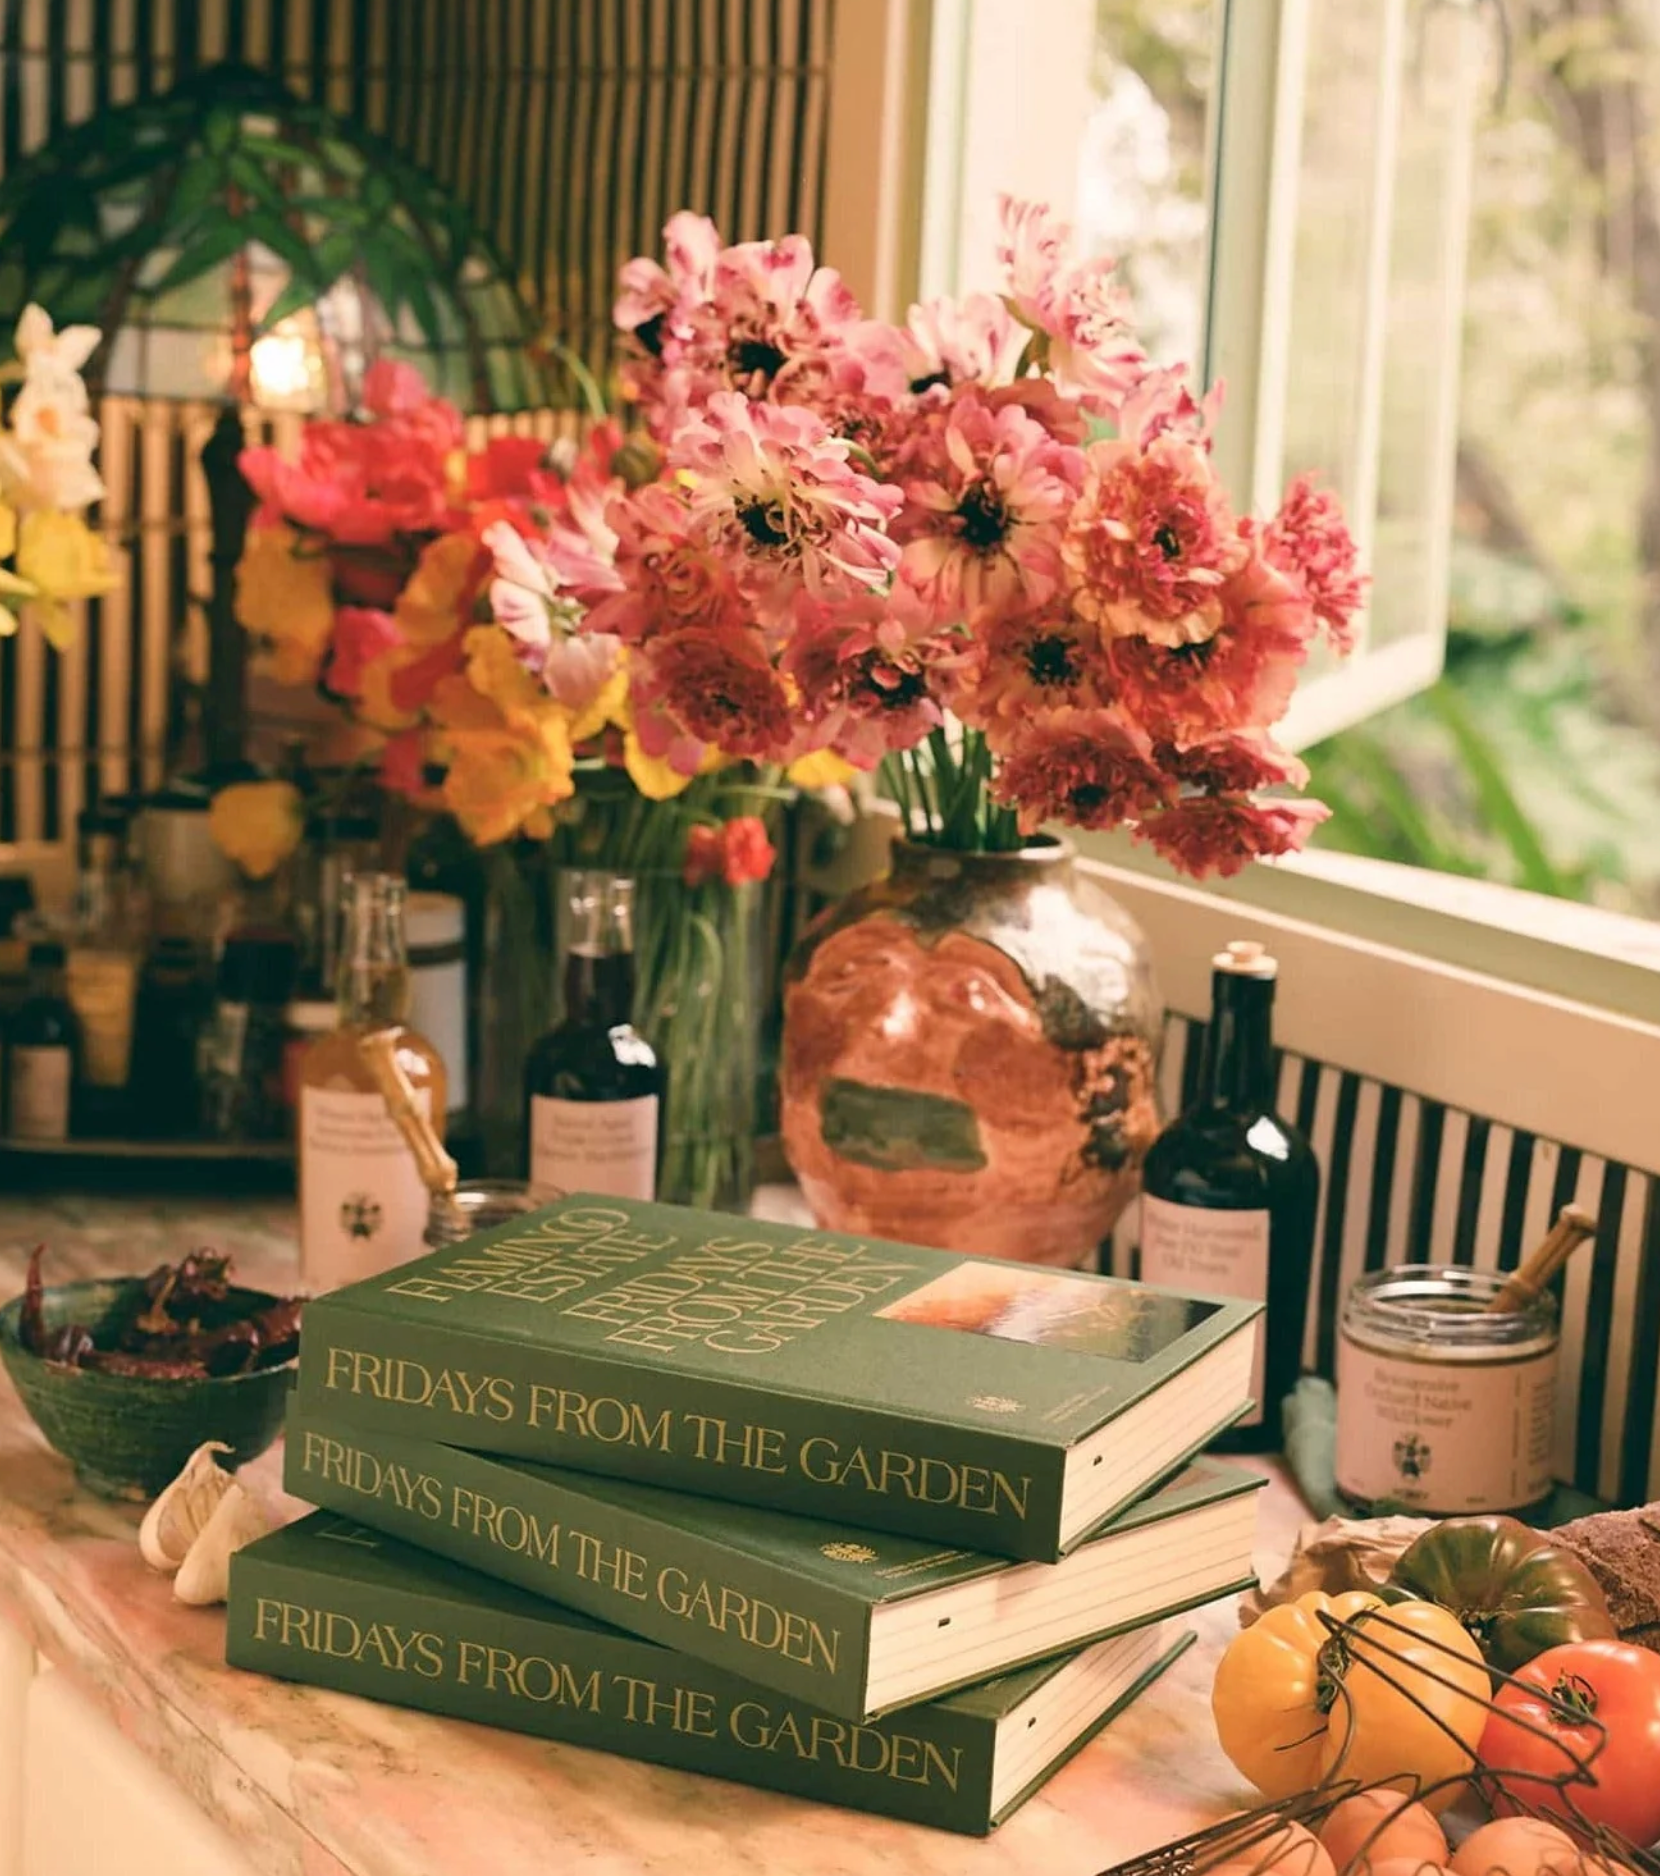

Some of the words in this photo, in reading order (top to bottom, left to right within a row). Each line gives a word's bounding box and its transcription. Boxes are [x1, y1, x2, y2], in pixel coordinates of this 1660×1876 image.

[385, 1207, 630, 1303] FLAMINGO
[484, 1229, 678, 1303] ESTATE
[560, 1237, 774, 1325] FRIDAYS
[604, 1281, 788, 1354] FROM
[736, 1236, 869, 1283] THE
[703, 1256, 920, 1354] GARDEN
[325, 1347, 515, 1422] FRIDAYS
[528, 1385, 672, 1453] FROM
[684, 1414, 787, 1473] THE
[801, 1437, 1032, 1521] GARDEN
[302, 1433, 442, 1518] FRIDAYS
[451, 1487, 562, 1568] FROM
[568, 1531, 648, 1601] THE
[657, 1567, 842, 1675] GARDEN
[254, 1598, 445, 1679] FRIDAYS
[457, 1642, 602, 1712] FROM
[612, 1674, 717, 1737] THE
[729, 1702, 963, 1793] GARDEN
